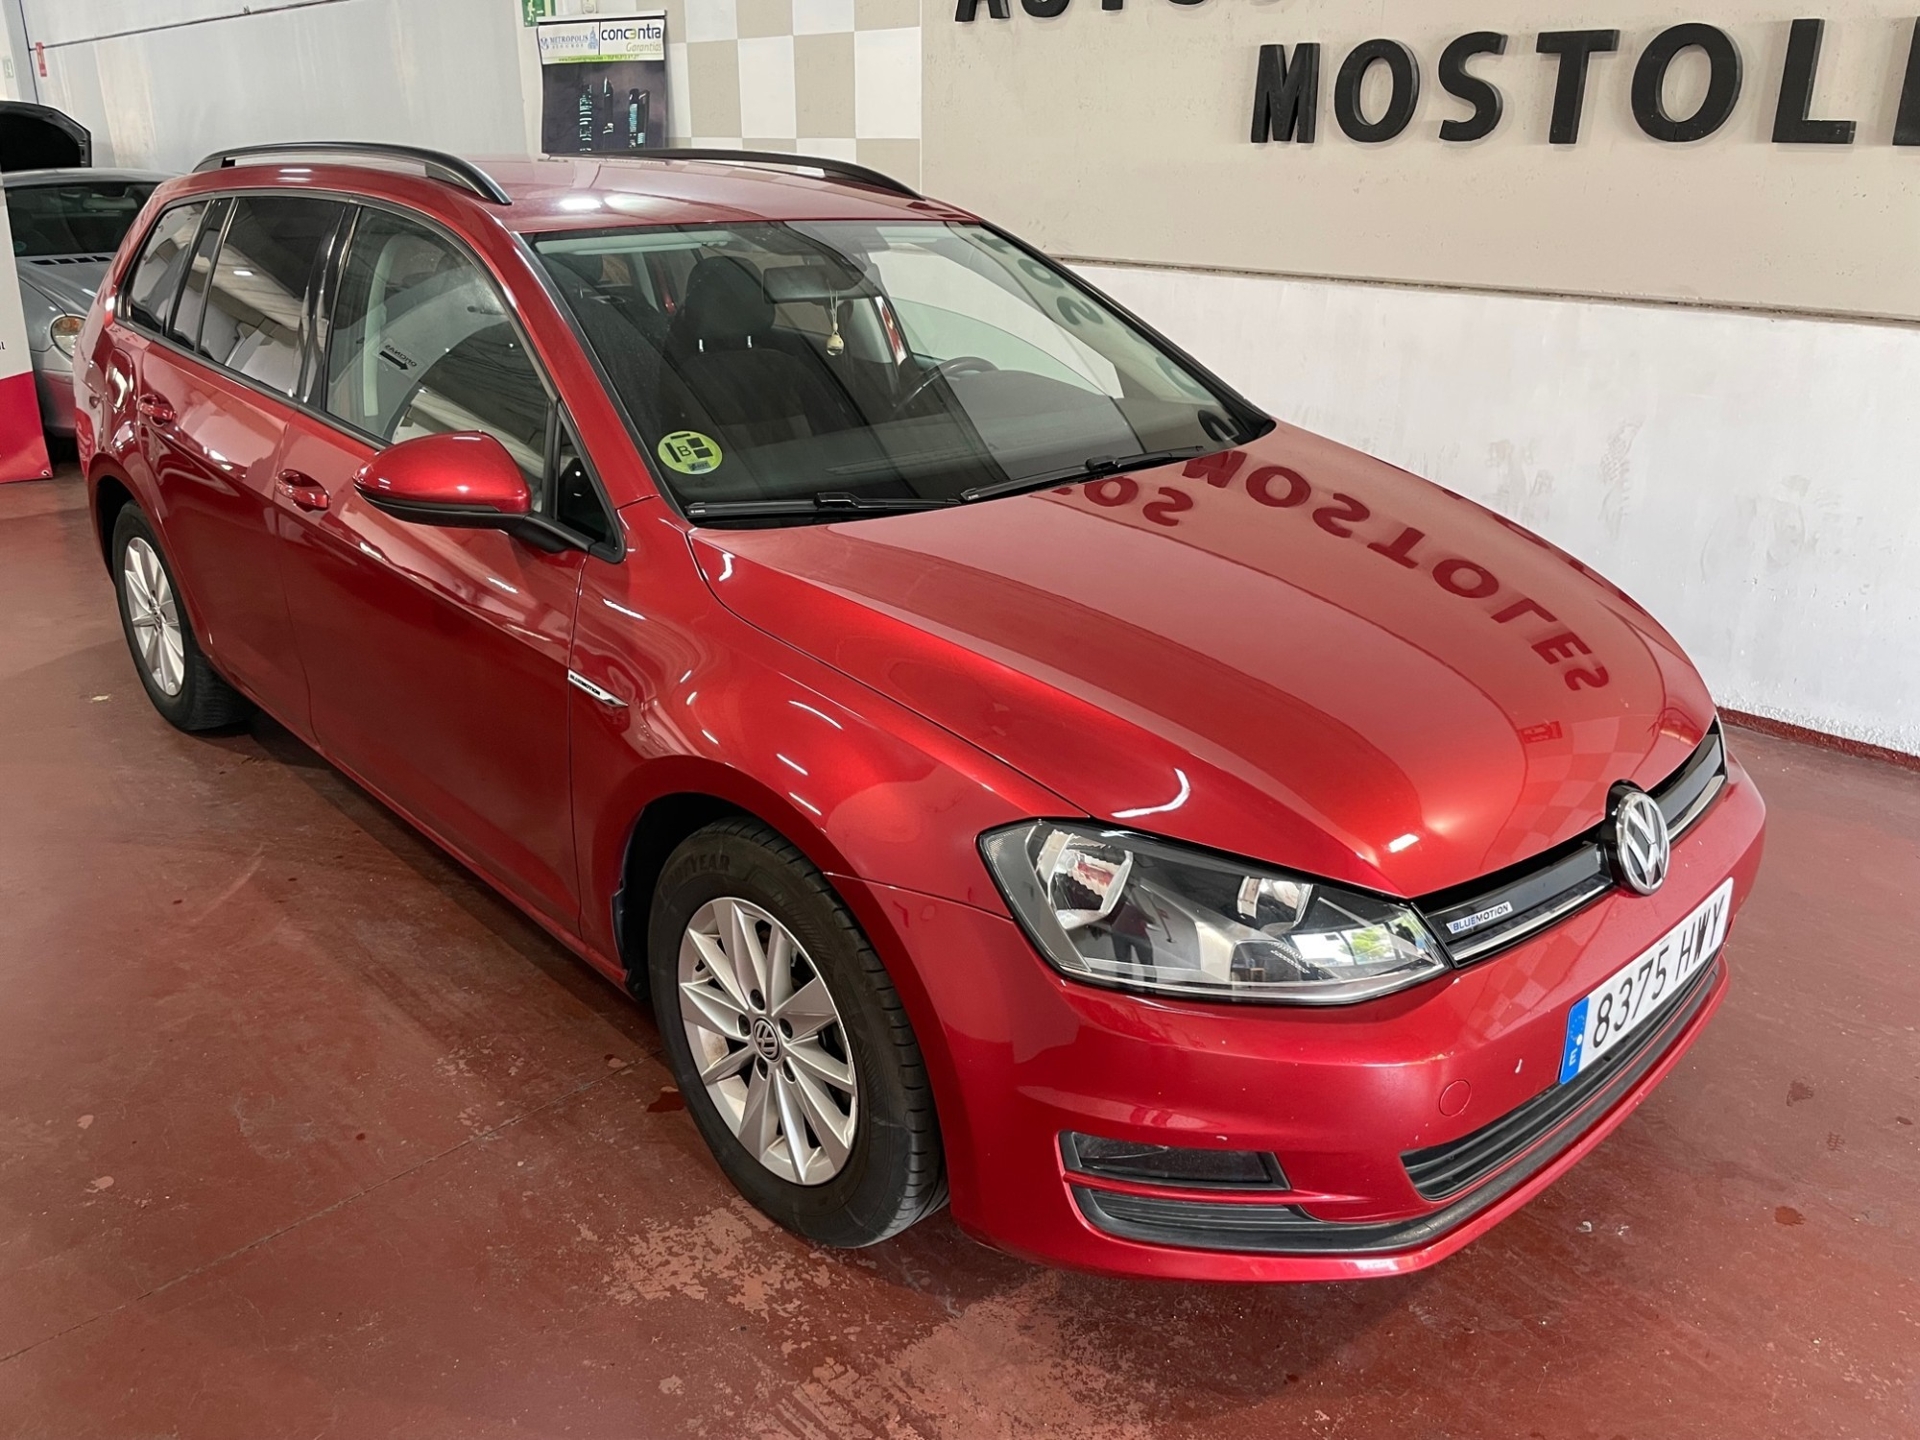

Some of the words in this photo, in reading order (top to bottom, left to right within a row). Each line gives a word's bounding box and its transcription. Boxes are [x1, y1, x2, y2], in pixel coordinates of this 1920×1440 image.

[677, 445, 691, 457] B
[1453, 904, 1509, 931] BLUEMOTION
[1593, 945, 1670, 1048] 8375
[1569, 1048, 1578, 1066] E
